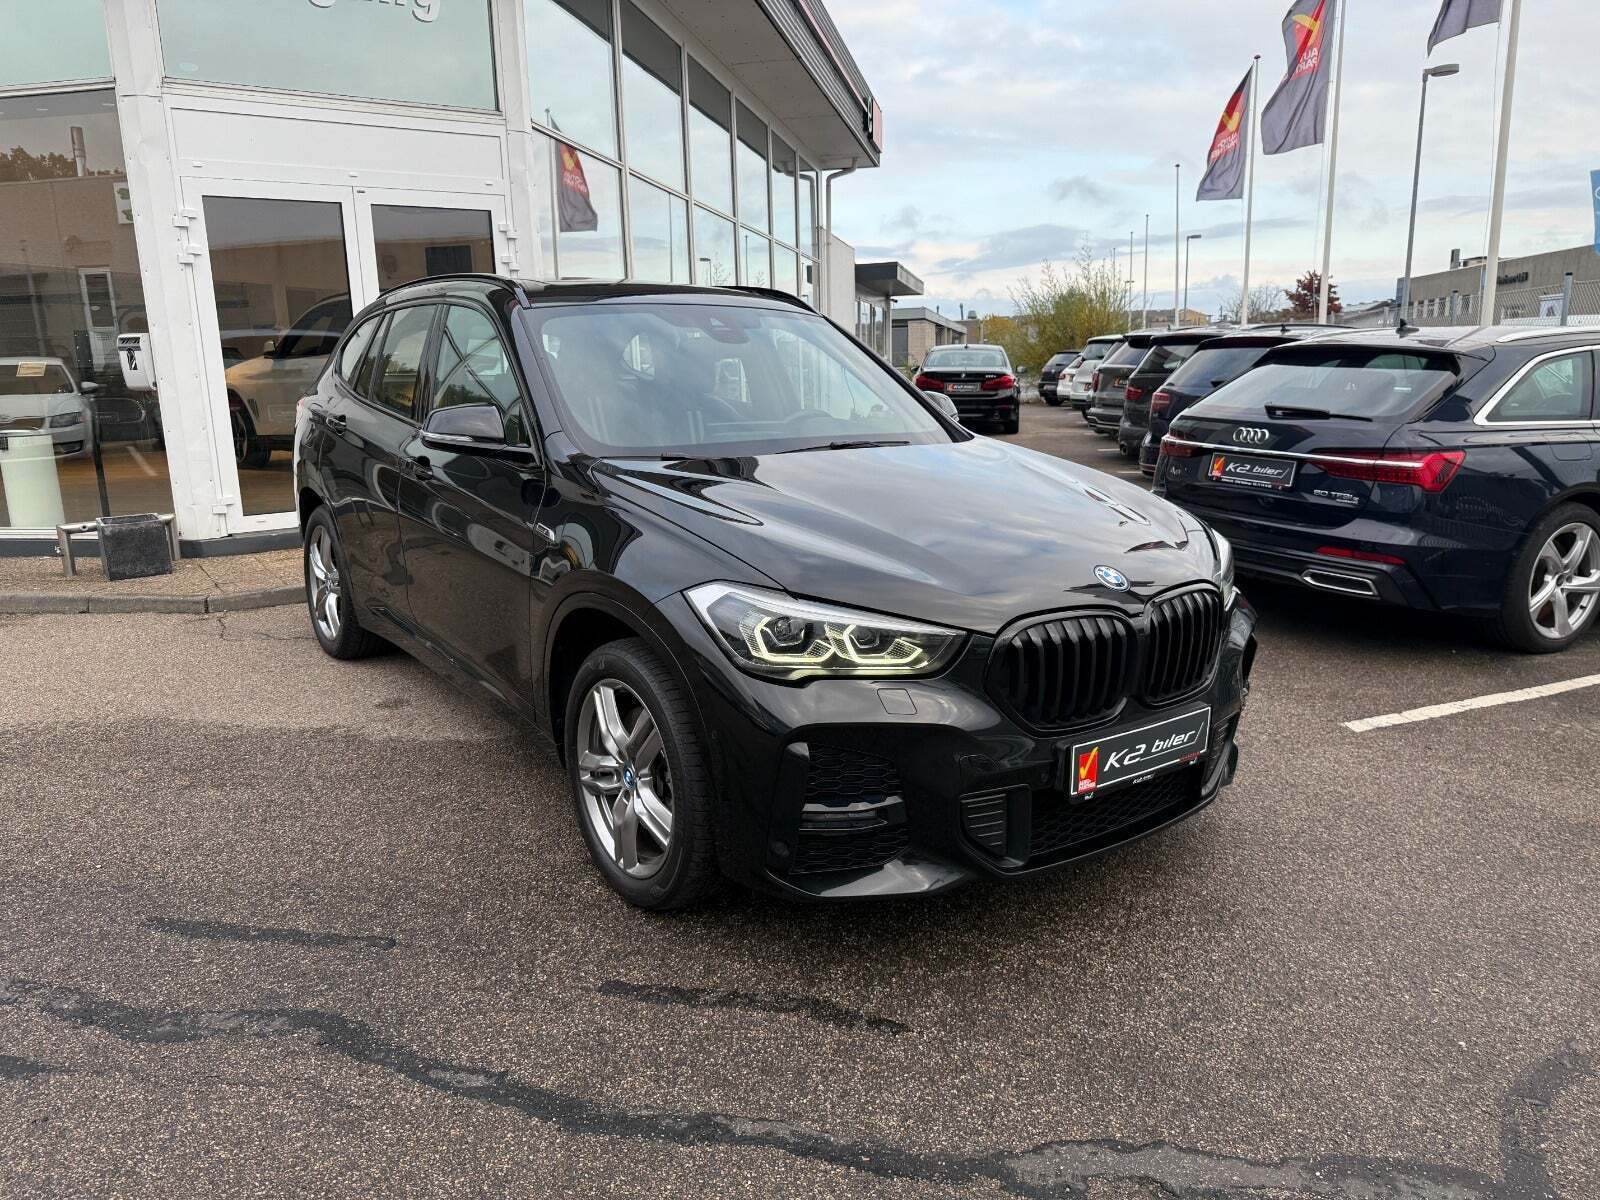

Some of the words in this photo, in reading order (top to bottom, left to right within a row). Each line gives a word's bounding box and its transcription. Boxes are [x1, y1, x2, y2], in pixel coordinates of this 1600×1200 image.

[1226, 462, 1251, 474] K2
[1252, 465, 1284, 476] biler
[1103, 743, 1147, 772] K2
[1150, 730, 1196, 753] biler
